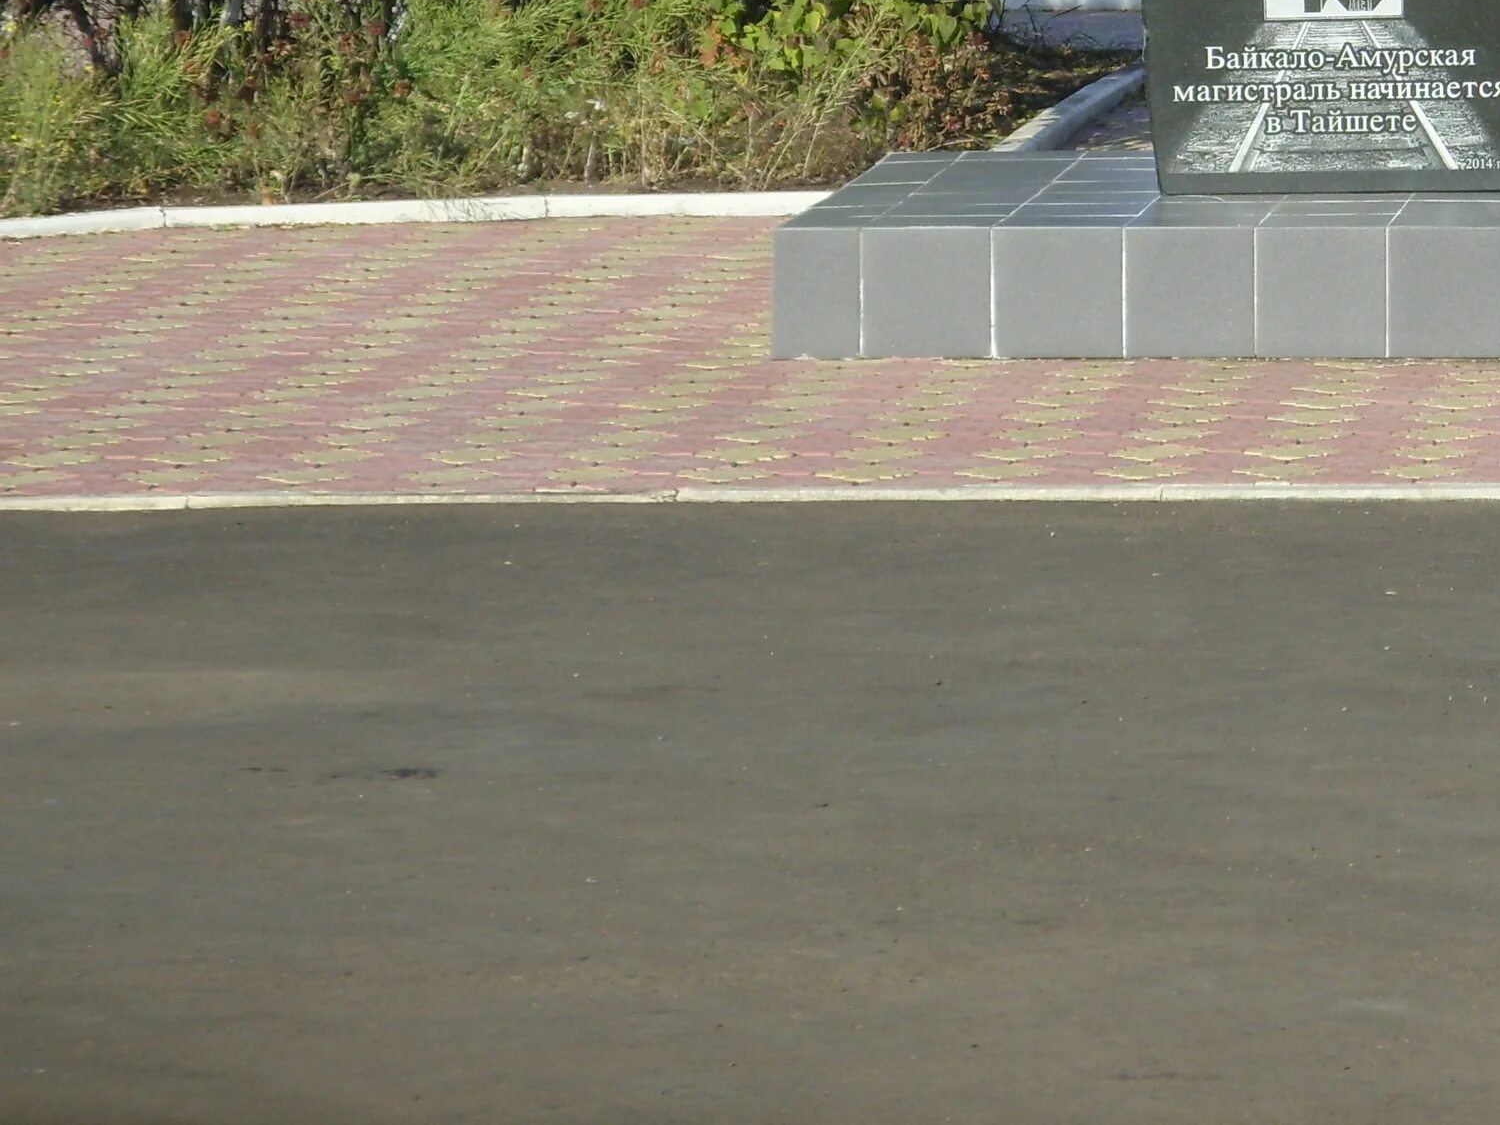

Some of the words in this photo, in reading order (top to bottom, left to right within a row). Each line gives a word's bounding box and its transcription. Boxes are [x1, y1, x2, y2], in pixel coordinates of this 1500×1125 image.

[1204, 44, 1476, 75] Байкало-Амурская
[1173, 80, 1341, 108] магистраль
[1265, 116, 1282, 133] в
[1291, 109, 1417, 133] Тайшете
[1465, 158, 1493, 170] 2014
